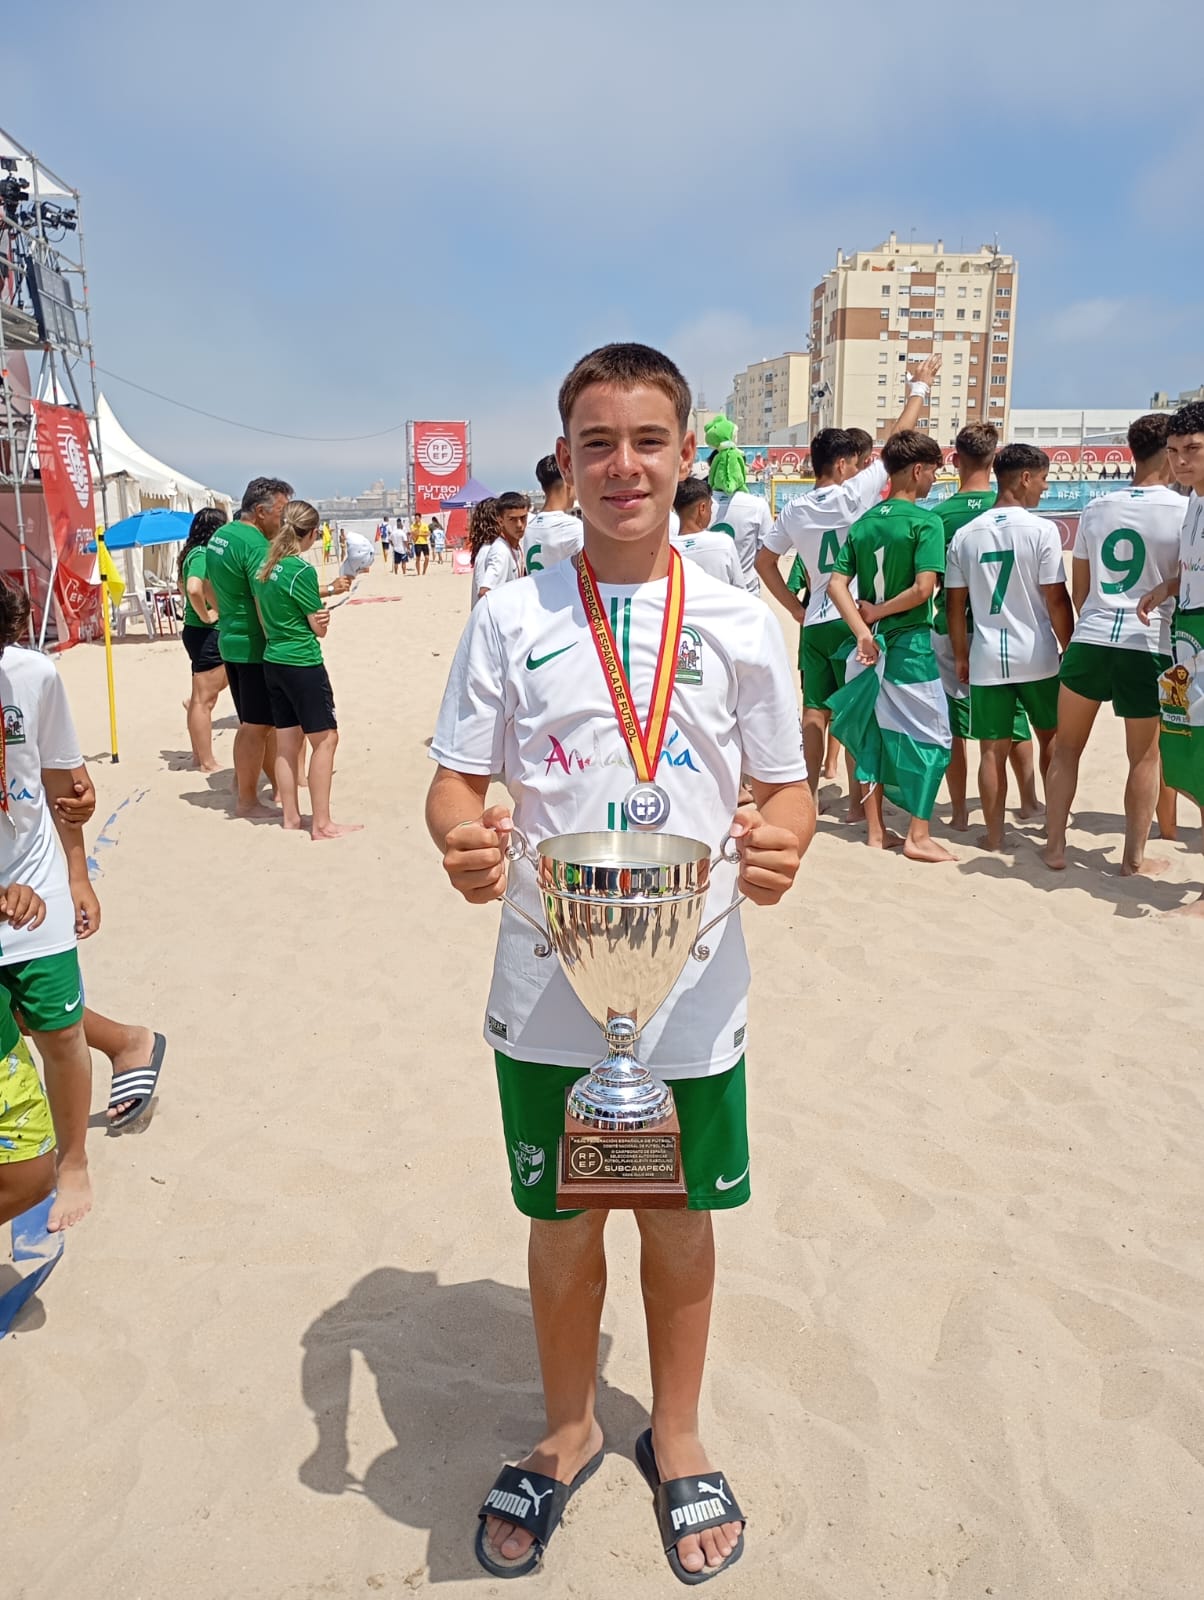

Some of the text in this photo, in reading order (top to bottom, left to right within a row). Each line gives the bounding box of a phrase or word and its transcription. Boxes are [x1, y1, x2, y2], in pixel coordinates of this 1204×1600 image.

[873, 546, 886, 605] 1
[979, 549, 1015, 616] 7
[1100, 527, 1147, 595] 9
[597, 630, 620, 685] ESPAÑOLA
[613, 684, 626, 700] DE
[604, 1163, 674, 1172] SUBCAMPEÓN
[484, 1488, 532, 1519] PUMA
[670, 1497, 726, 1531] PUMA
